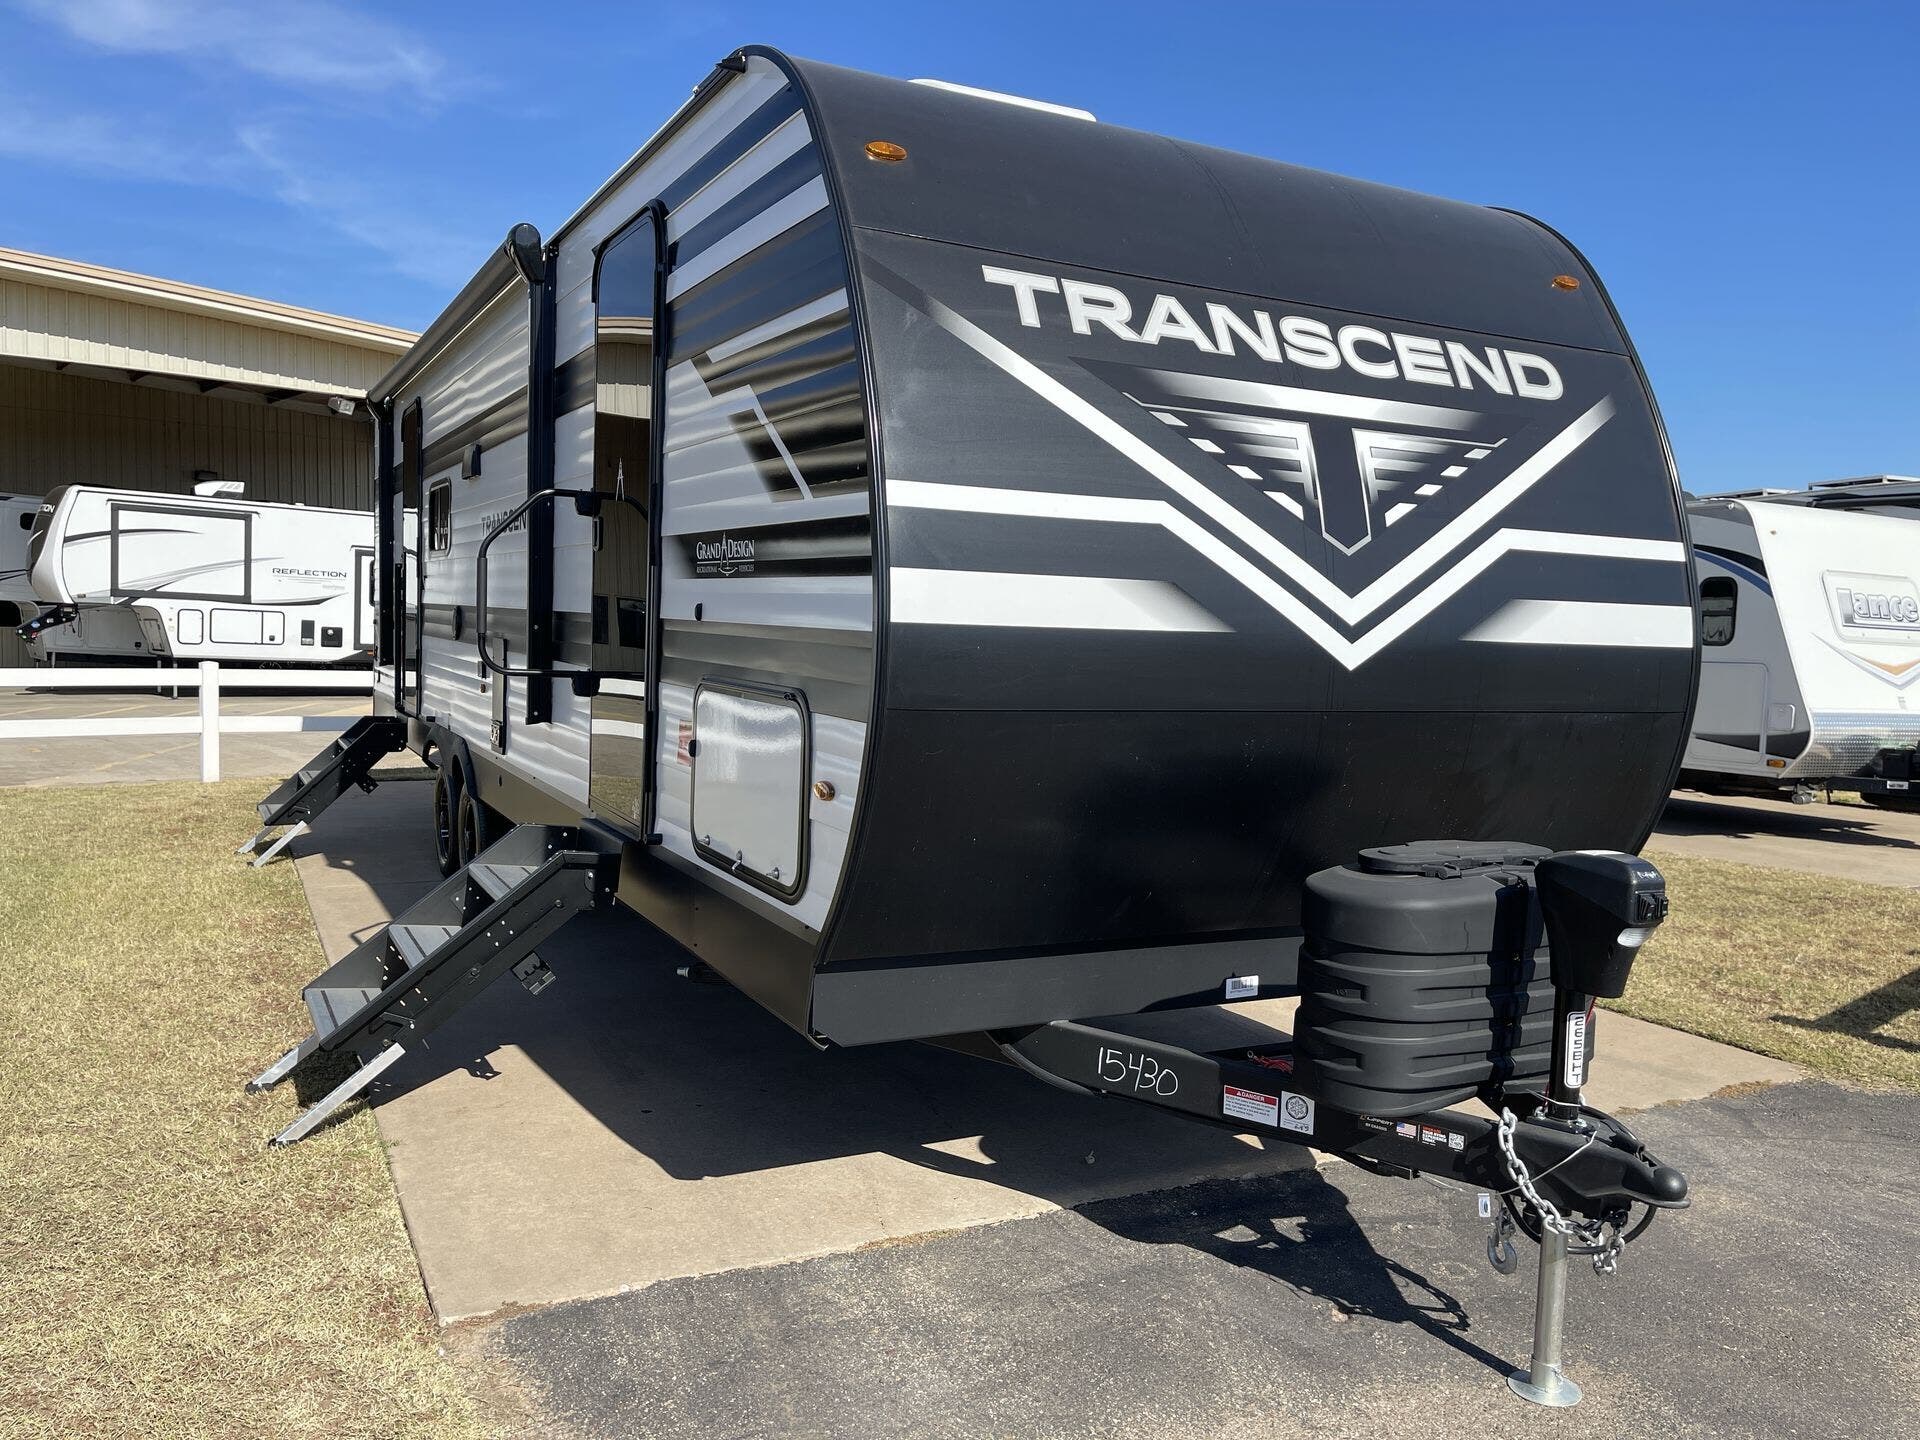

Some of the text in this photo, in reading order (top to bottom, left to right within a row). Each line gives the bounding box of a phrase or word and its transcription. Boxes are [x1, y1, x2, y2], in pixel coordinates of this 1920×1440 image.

[982, 264, 1565, 400] TRANSCEND
[696, 539, 755, 560] GRAND DESIGN
[272, 567, 347, 578] REFLECTION
[1836, 587, 1919, 626] Lance
[1097, 1047, 1178, 1096] 15430
[1241, 1092, 1265, 1102] DANGER
